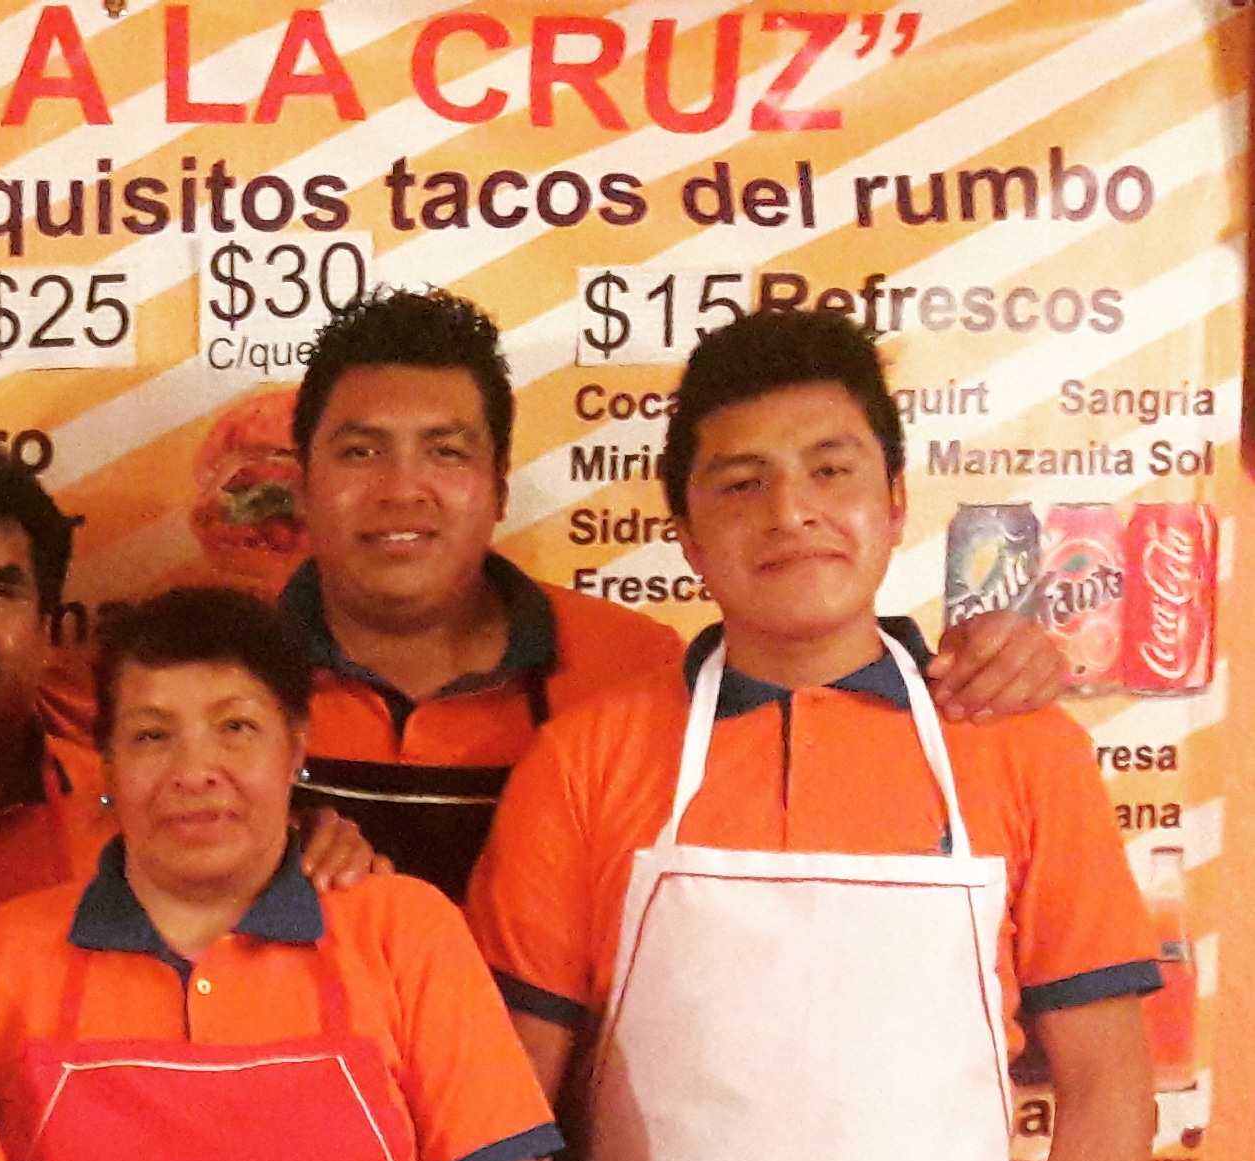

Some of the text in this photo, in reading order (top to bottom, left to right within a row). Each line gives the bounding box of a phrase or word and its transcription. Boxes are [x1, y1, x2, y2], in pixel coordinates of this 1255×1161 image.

[166, 3, 366, 126] LA
[386, 156, 649, 230] tacos
[681, 161, 816, 230] del
[855, 146, 1156, 228] rumbo
[209, 240, 366, 330] $30
[583, 271, 744, 359] $15
[760, 272, 1126, 335] Refrescos
[208, 337, 315, 375] C/que
[893, 380, 990, 424] quirt
[1060, 380, 1216, 424] Sangria
[928, 439, 1214, 476] Manzanita Sol
